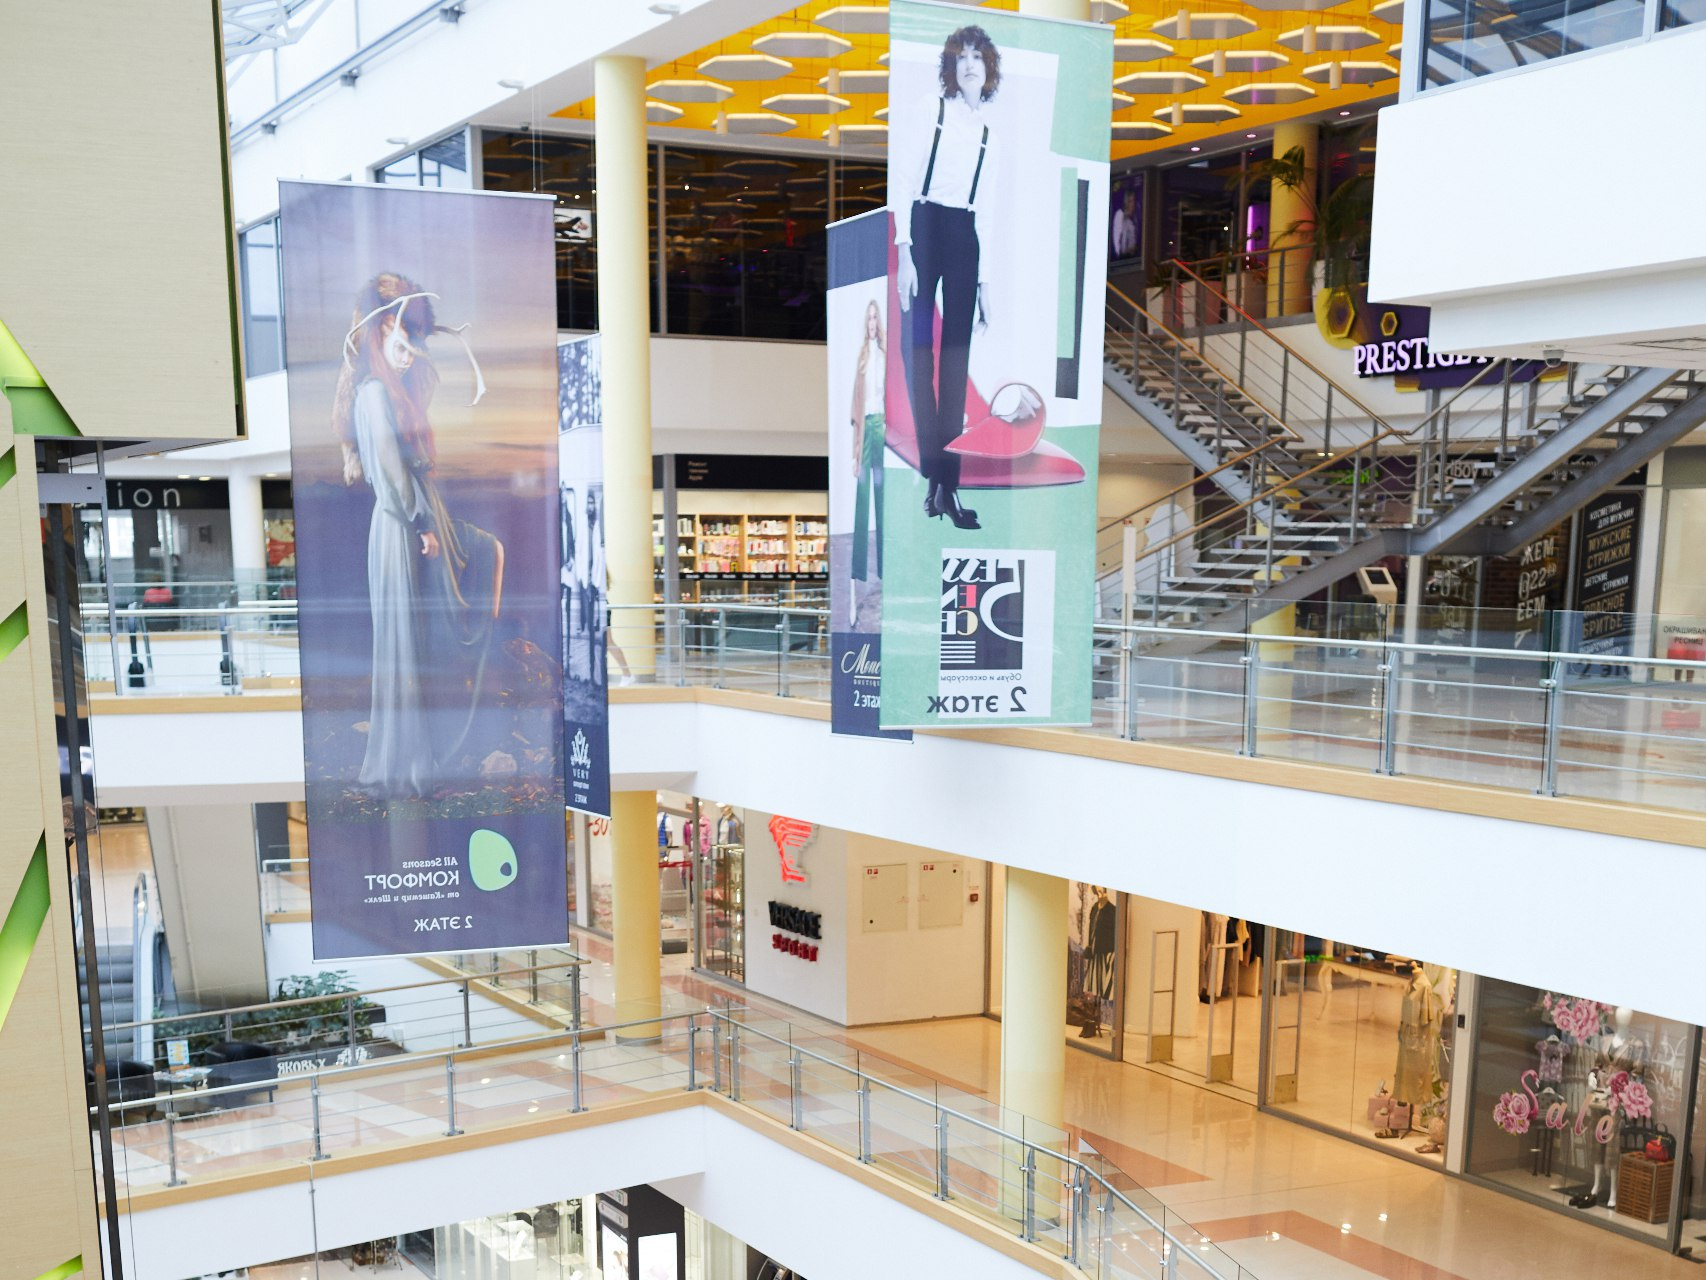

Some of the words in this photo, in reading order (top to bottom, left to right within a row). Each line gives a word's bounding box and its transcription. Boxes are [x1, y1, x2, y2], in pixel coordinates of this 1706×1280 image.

[117, 482, 182, 508] ion
[1588, 525, 1632, 552] МУЖСКИЕ
[1586, 542, 1631, 569] СТРИЖКИ
[1583, 611, 1623, 639] БРИТЬЕ
[853, 689, 861, 707] 2
[572, 768, 590, 780] VERY
